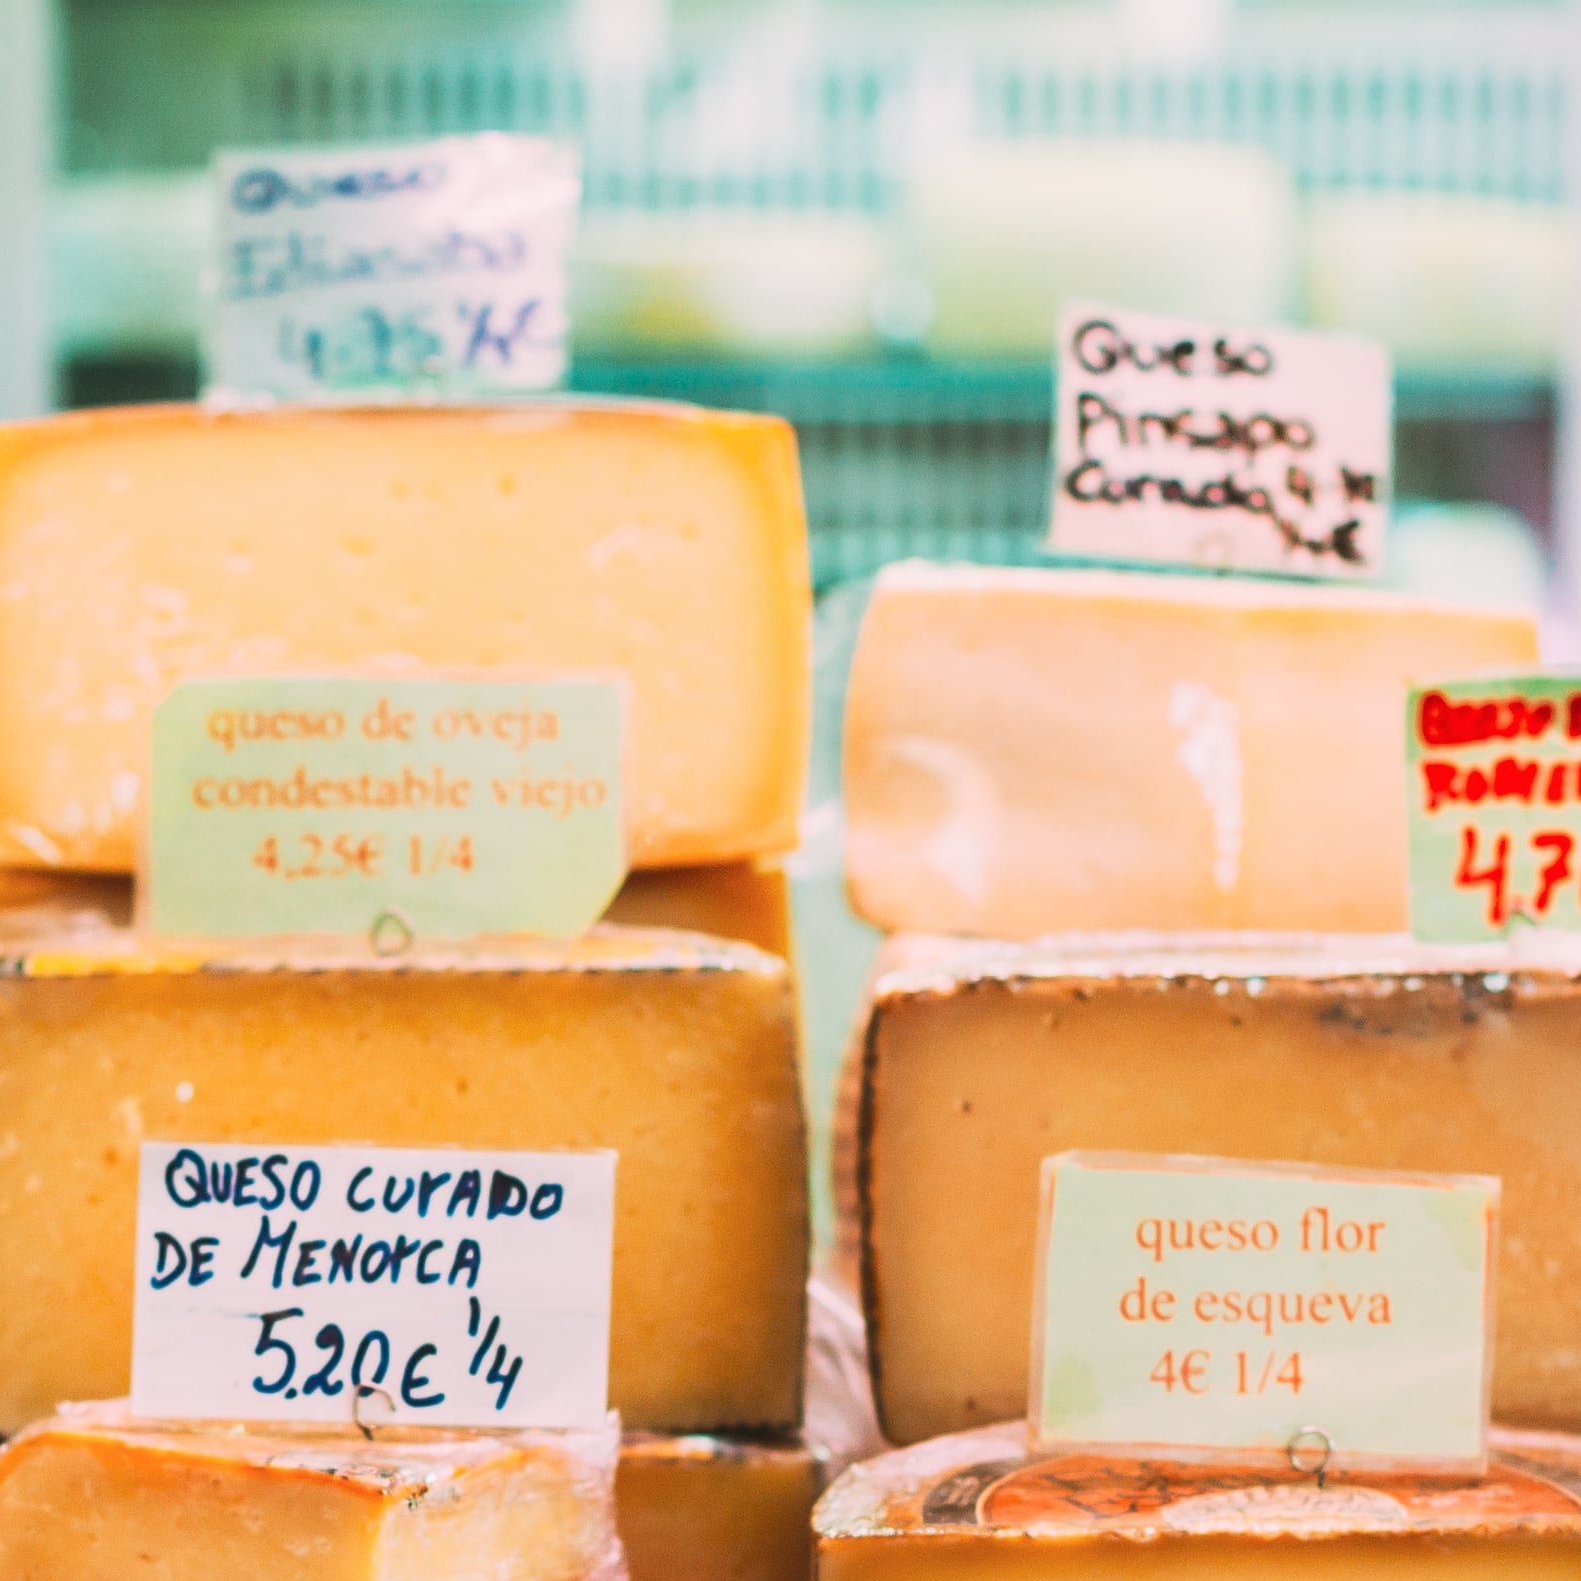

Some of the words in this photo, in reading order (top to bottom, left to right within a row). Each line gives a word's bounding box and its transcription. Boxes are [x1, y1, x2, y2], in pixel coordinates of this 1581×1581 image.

[206, 704, 347, 753] queso
[360, 697, 417, 742] de
[431, 700, 561, 753] oveja
[191, 765, 473, 811] condestable
[164, 1147, 321, 1211] QUESO
[150, 1231, 220, 1289] DE
[1135, 1214, 1280, 1263] queso
[1299, 1205, 1386, 1254] flor
[1118, 1276, 1177, 1323] de
[1193, 1289, 1393, 1337] esqueva
[1148, 1347, 1212, 1395] 4€
[1234, 1348, 1306, 1396] 1/4
